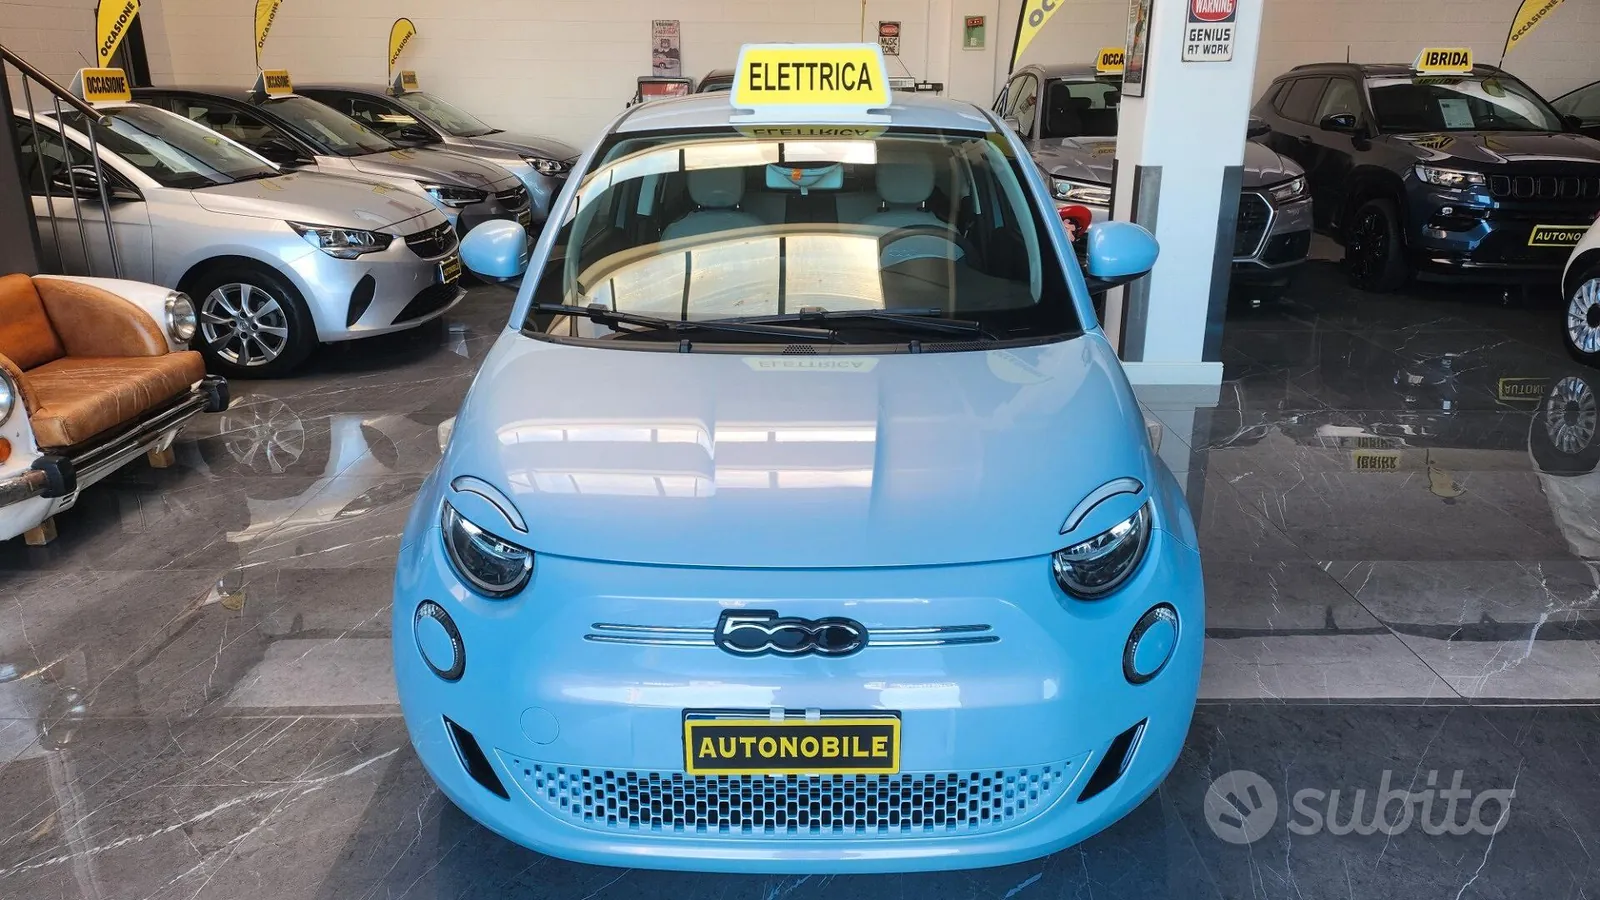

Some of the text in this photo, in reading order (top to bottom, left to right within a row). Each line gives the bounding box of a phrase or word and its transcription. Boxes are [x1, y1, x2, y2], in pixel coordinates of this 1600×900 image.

[100, 1, 136, 57] OCCASIONE
[258, 1, 279, 48] OCCASIONE
[880, 37, 898, 46] MUSIC
[1189, 28, 1231, 42] GENIUS
[391, 30, 413, 65] OCCASIONE
[1187, 44, 1230, 55] AT WORK
[1425, 51, 1469, 66] IBRIDA
[86, 76, 126, 94] OCCASIONE
[749, 62, 873, 91] ELETTRICA
[1535, 232, 1582, 241] AUTONO
[716, 610, 866, 658] 500
[698, 735, 888, 758] AUTONOBILE
